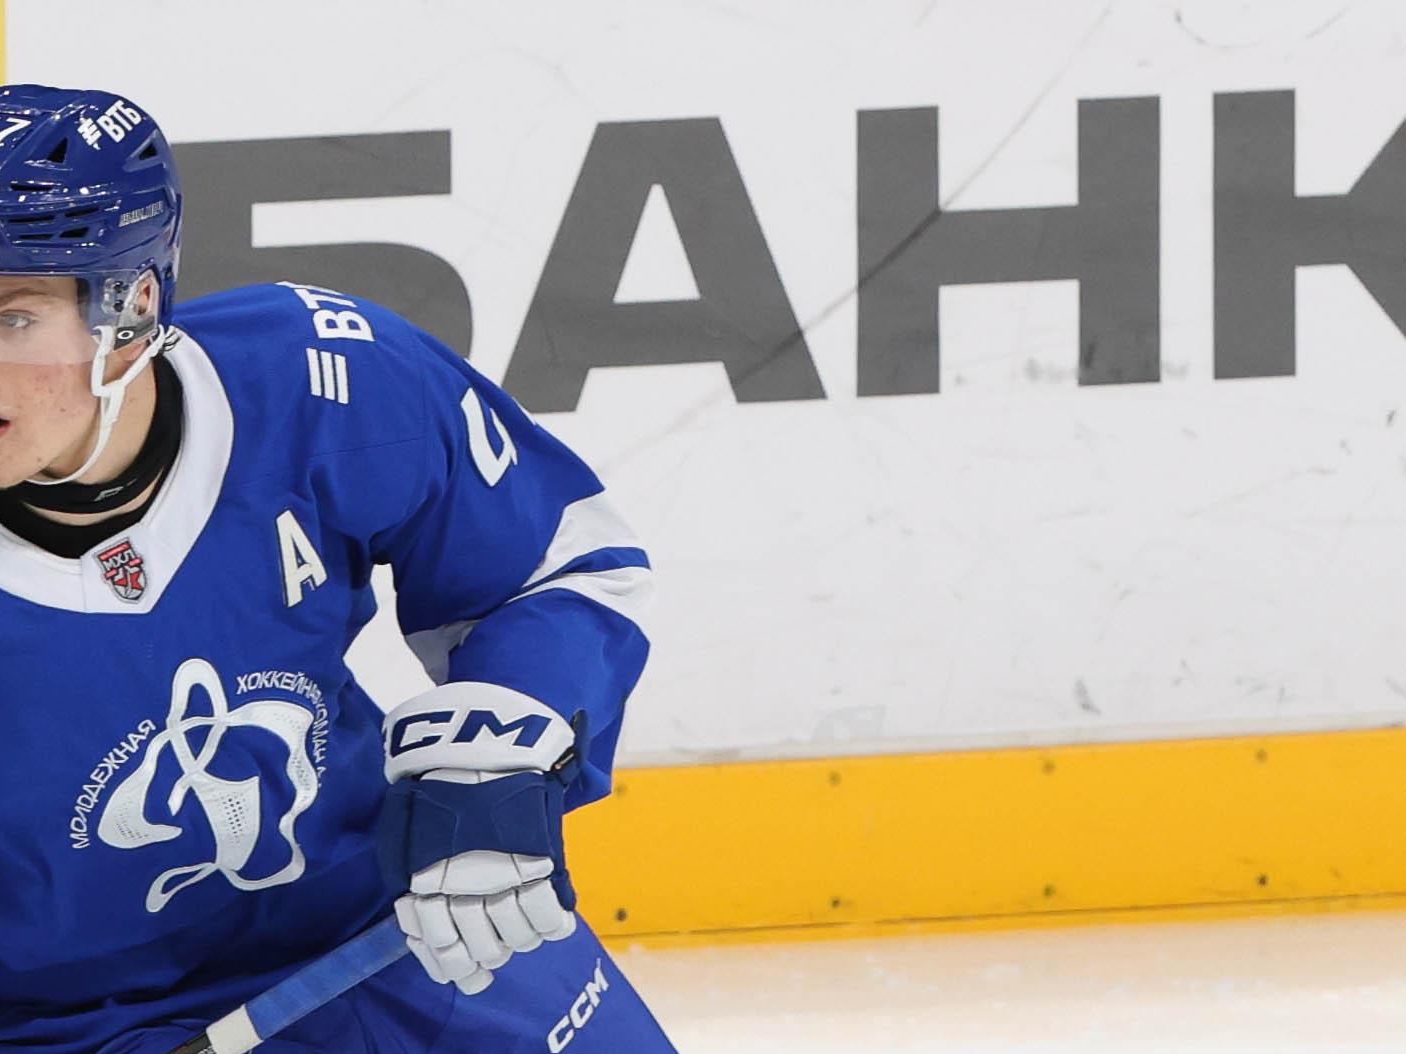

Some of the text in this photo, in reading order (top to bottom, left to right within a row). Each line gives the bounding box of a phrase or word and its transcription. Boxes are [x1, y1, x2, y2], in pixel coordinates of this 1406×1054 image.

[96, 99, 143, 144] ВТБ
[167, 87, 1406, 415] БАНК
[273, 280, 377, 342] ВТ
[460, 386, 536, 488] 4
[69, 718, 157, 850] МОЛОДЕЖНАЯ
[546, 966, 610, 1054] CCM
